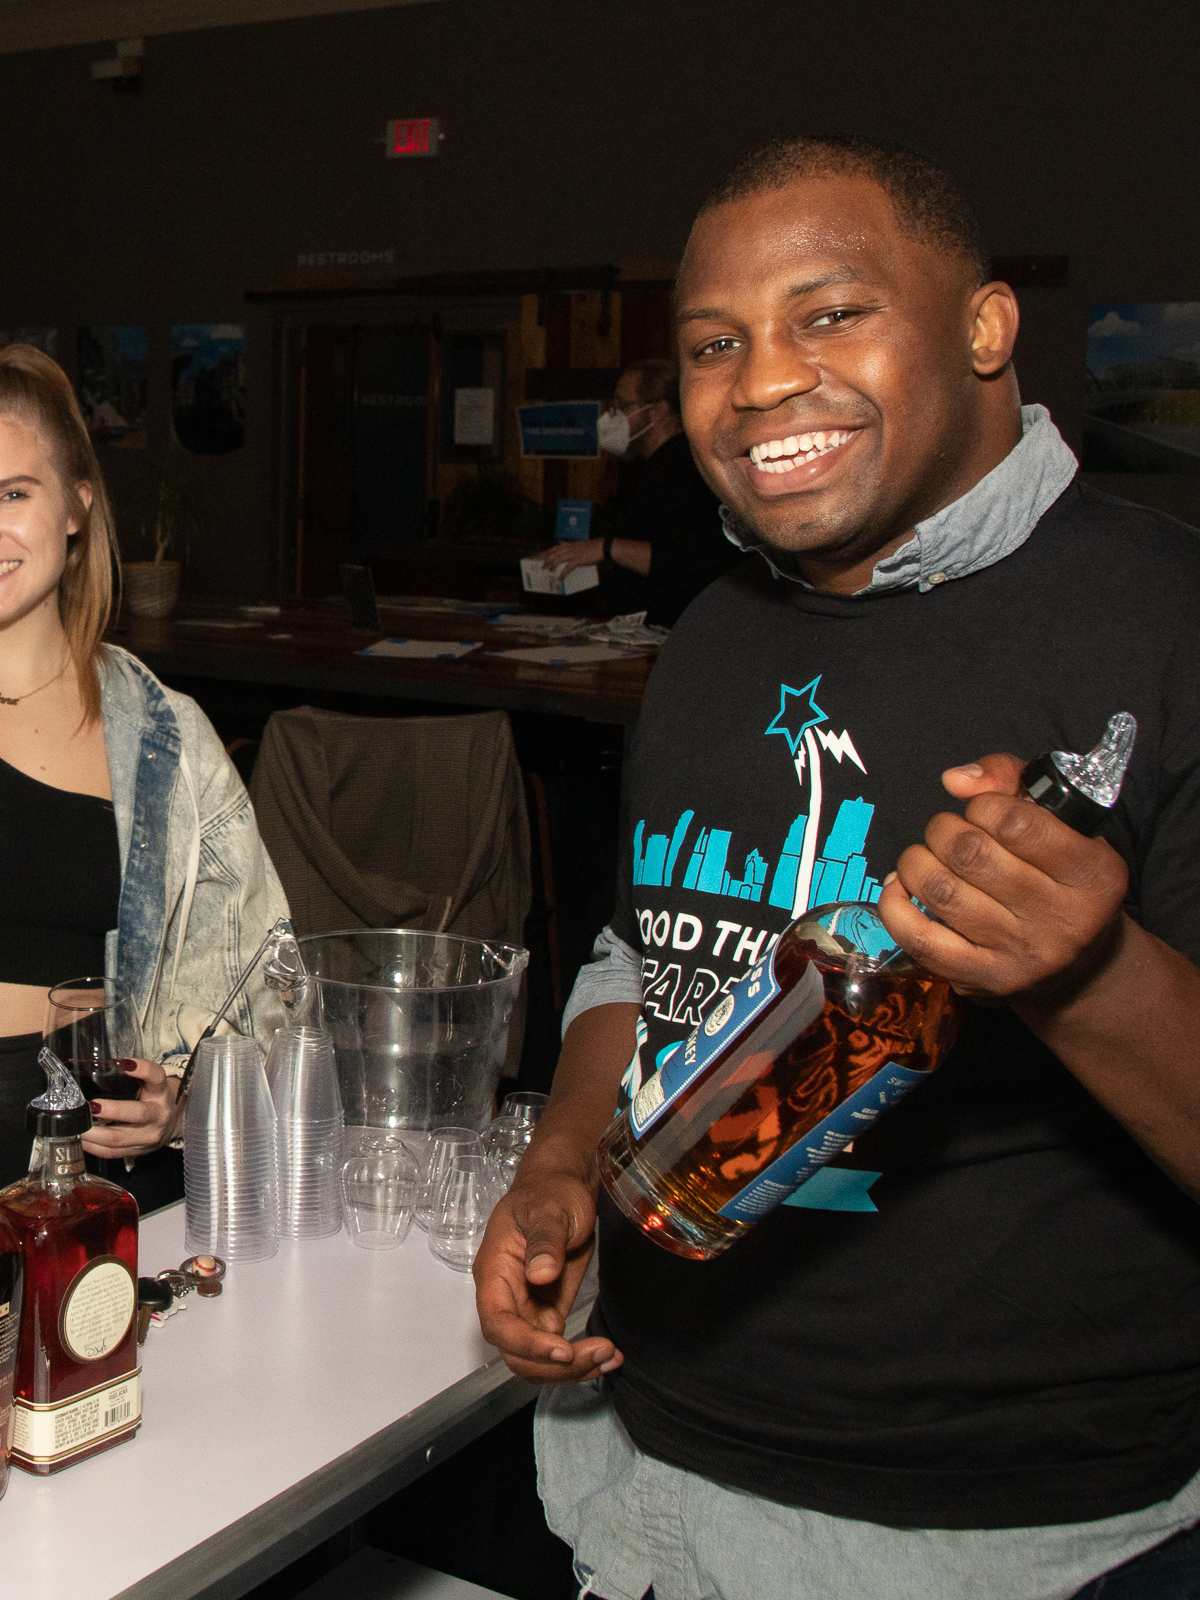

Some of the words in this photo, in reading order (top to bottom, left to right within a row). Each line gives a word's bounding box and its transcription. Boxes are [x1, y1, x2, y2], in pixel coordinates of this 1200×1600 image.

[395, 119, 431, 153] EXIT
[297, 249, 394, 267] RESTROOMS
[636, 908, 703, 951] OOD
